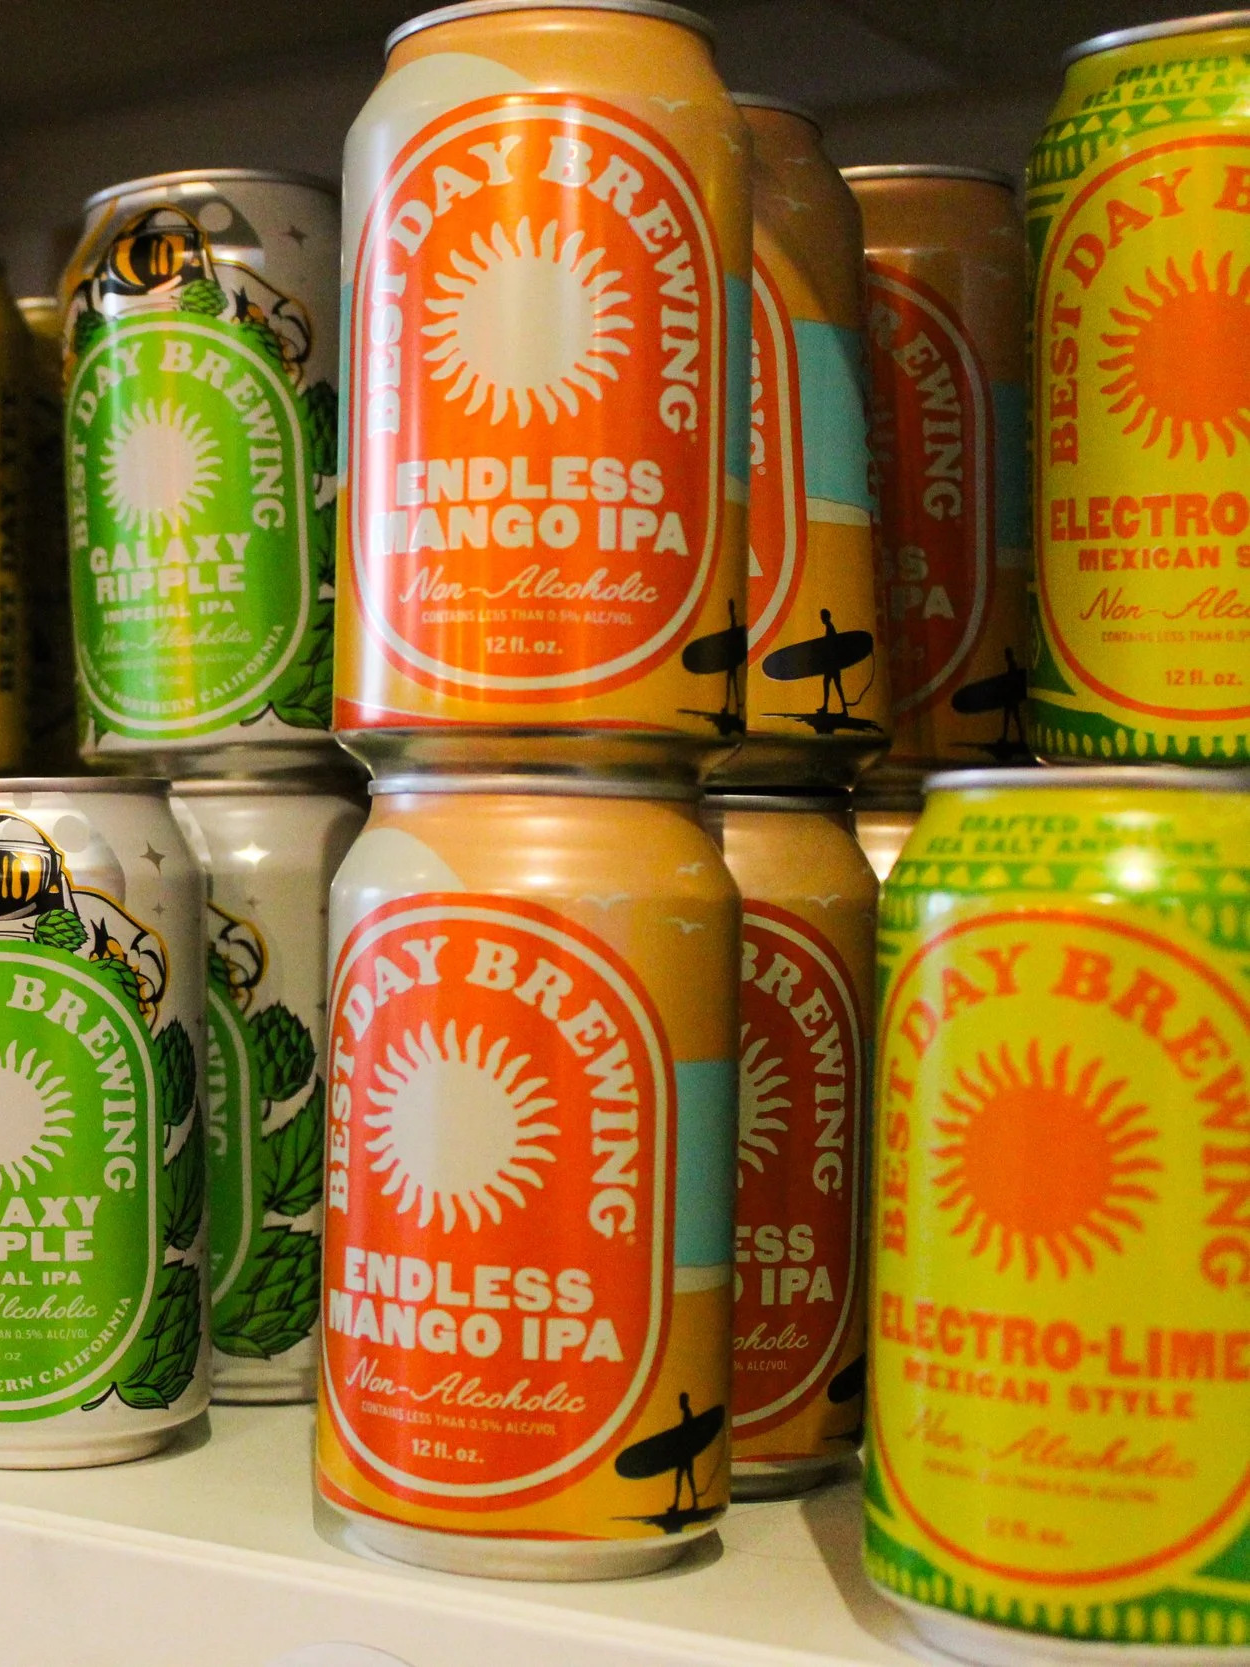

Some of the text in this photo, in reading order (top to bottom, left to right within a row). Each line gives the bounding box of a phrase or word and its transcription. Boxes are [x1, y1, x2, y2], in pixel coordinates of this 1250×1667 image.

[368, 259, 407, 438] BEST
[388, 135, 522, 256] DAY
[539, 136, 700, 434] BREWING
[1049, 166, 1193, 465] BEST DAY
[872, 300, 963, 521] REWING
[76, 342, 144, 428] DAY
[159, 339, 287, 532] BREWING
[396, 456, 665, 506] ENDLESS
[89, 533, 251, 575] GALAXY
[369, 504, 690, 557] MANGO IPA
[1078, 546, 1220, 571] MEXICAN
[96, 563, 245, 604] RIPPLE
[399, 564, 659, 603] Non-Alcoholic
[103, 600, 235, 625] IMPERIAL IPA
[510, 608, 544, 621] THAN
[199, 625, 286, 703] CALIFORNIA
[485, 637, 505, 654] 12
[533, 640, 563, 655] oz.
[1166, 669, 1185, 686] 12
[6, 974, 137, 1193] BREWING
[329, 935, 640, 1239] BEST DAY BREWING
[883, 942, 1250, 1288] BEST DAY BREWING
[42, 1270, 82, 1286] IPA
[343, 1246, 595, 1315] ENDLESS
[760, 1266, 835, 1305] IPA
[15, 1328, 43, 1340] 0.5%
[46, 1329, 90, 1340] ALC/VOL
[39, 1296, 132, 1385] CALIFORNIA
[328, 1288, 624, 1363] MANGO IPA
[880, 1291, 1250, 1382] ELECTRO-LIME
[5, 1351, 22, 1362] oz
[904, 1356, 1049, 1405] MEXICAN
[345, 1356, 587, 1414] Non-Alcoholic
[1067, 1384, 1195, 1420] STYLE
[361, 1401, 405, 1422] CONTAINS
[406, 1409, 432, 1425] LESS
[435, 1413, 466, 1428] THAN
[469, 1417, 502, 1432] 0.5%
[411, 1437, 485, 1464] 12 fl. oz.
